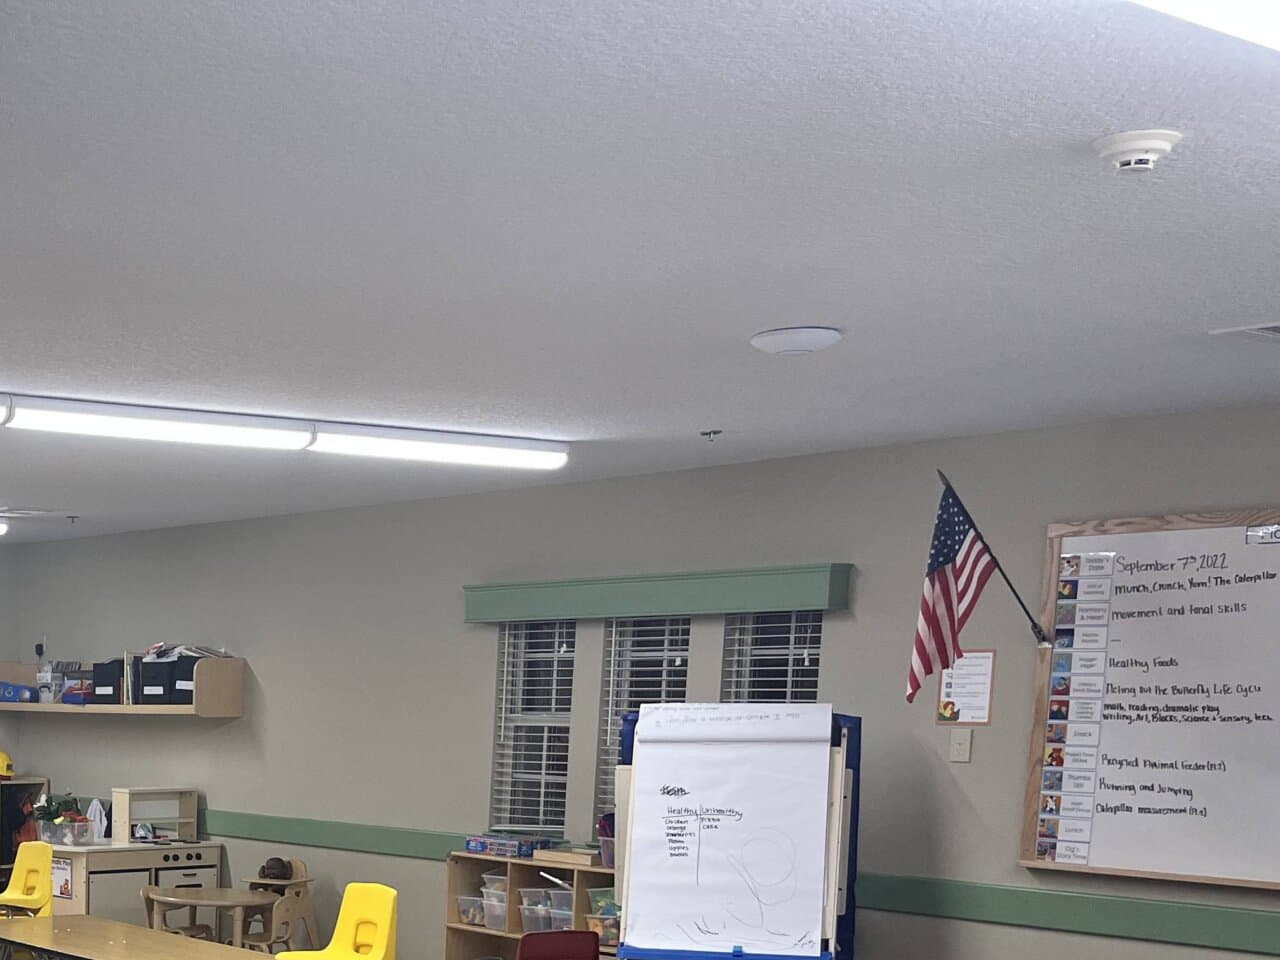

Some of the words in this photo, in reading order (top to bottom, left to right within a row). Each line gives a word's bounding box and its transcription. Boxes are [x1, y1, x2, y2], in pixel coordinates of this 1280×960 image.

[1116, 556, 1176, 574] September
[1213, 576, 1232, 586] The
[1168, 606, 1185, 616] and
[1108, 657, 1150, 673] Healthy
[1152, 656, 1178, 668] Foods
[1106, 683, 1136, 698] Acting
[1139, 686, 1152, 694] out
[1154, 684, 1168, 696] the
[1171, 684, 1210, 698] Butterfly
[1214, 684, 1232, 695] Life
[1236, 684, 1262, 697] Cycle
[1202, 704, 1220, 715] play
[1099, 777, 1136, 796] Running
[1139, 784, 1154, 792] and
[1157, 784, 1193, 801] Jumping
[667, 806, 698, 820] Healthy
[701, 808, 743, 822] Unhealthy
